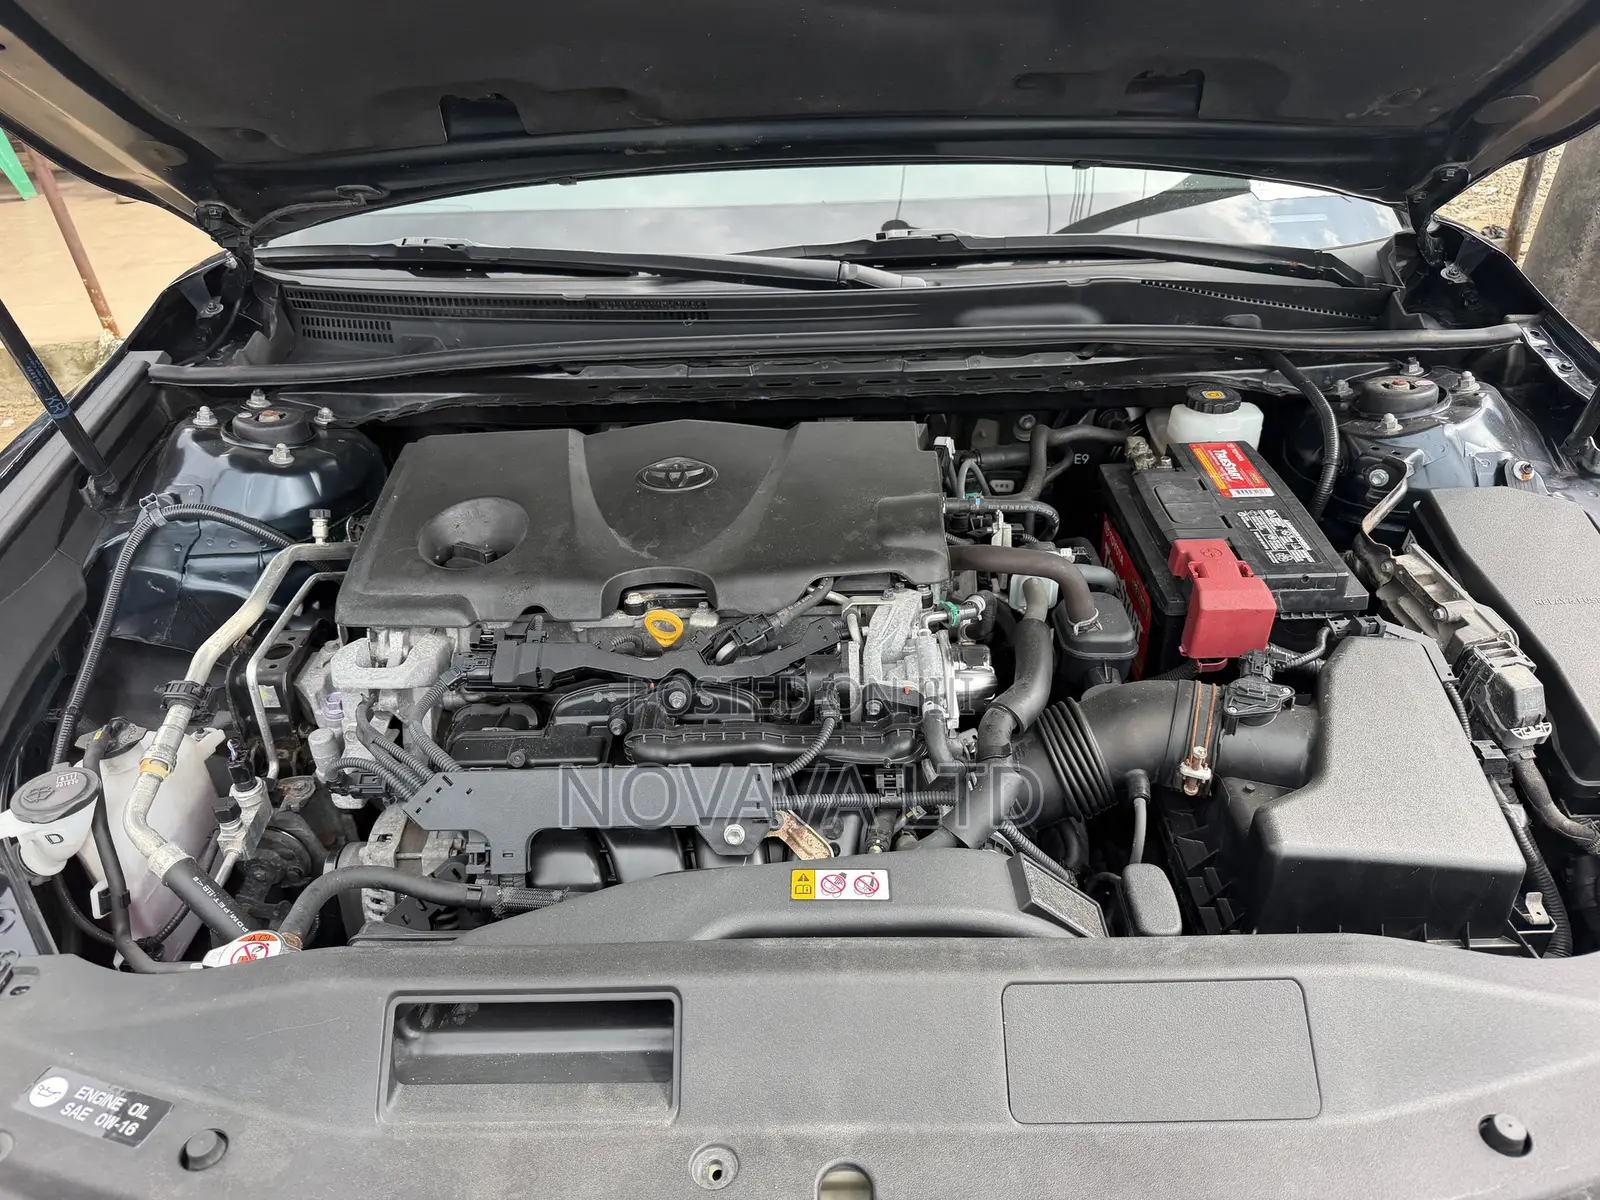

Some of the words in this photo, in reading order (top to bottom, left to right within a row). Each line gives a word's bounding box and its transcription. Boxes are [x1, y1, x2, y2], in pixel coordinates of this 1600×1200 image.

[1074, 453, 1089, 464] E9
[60, 1102, 94, 1121] SAE
[94, 1112, 140, 1136] 0W-16
[74, 1085, 128, 1112] ENGINE
[128, 1102, 150, 1120] OIL
